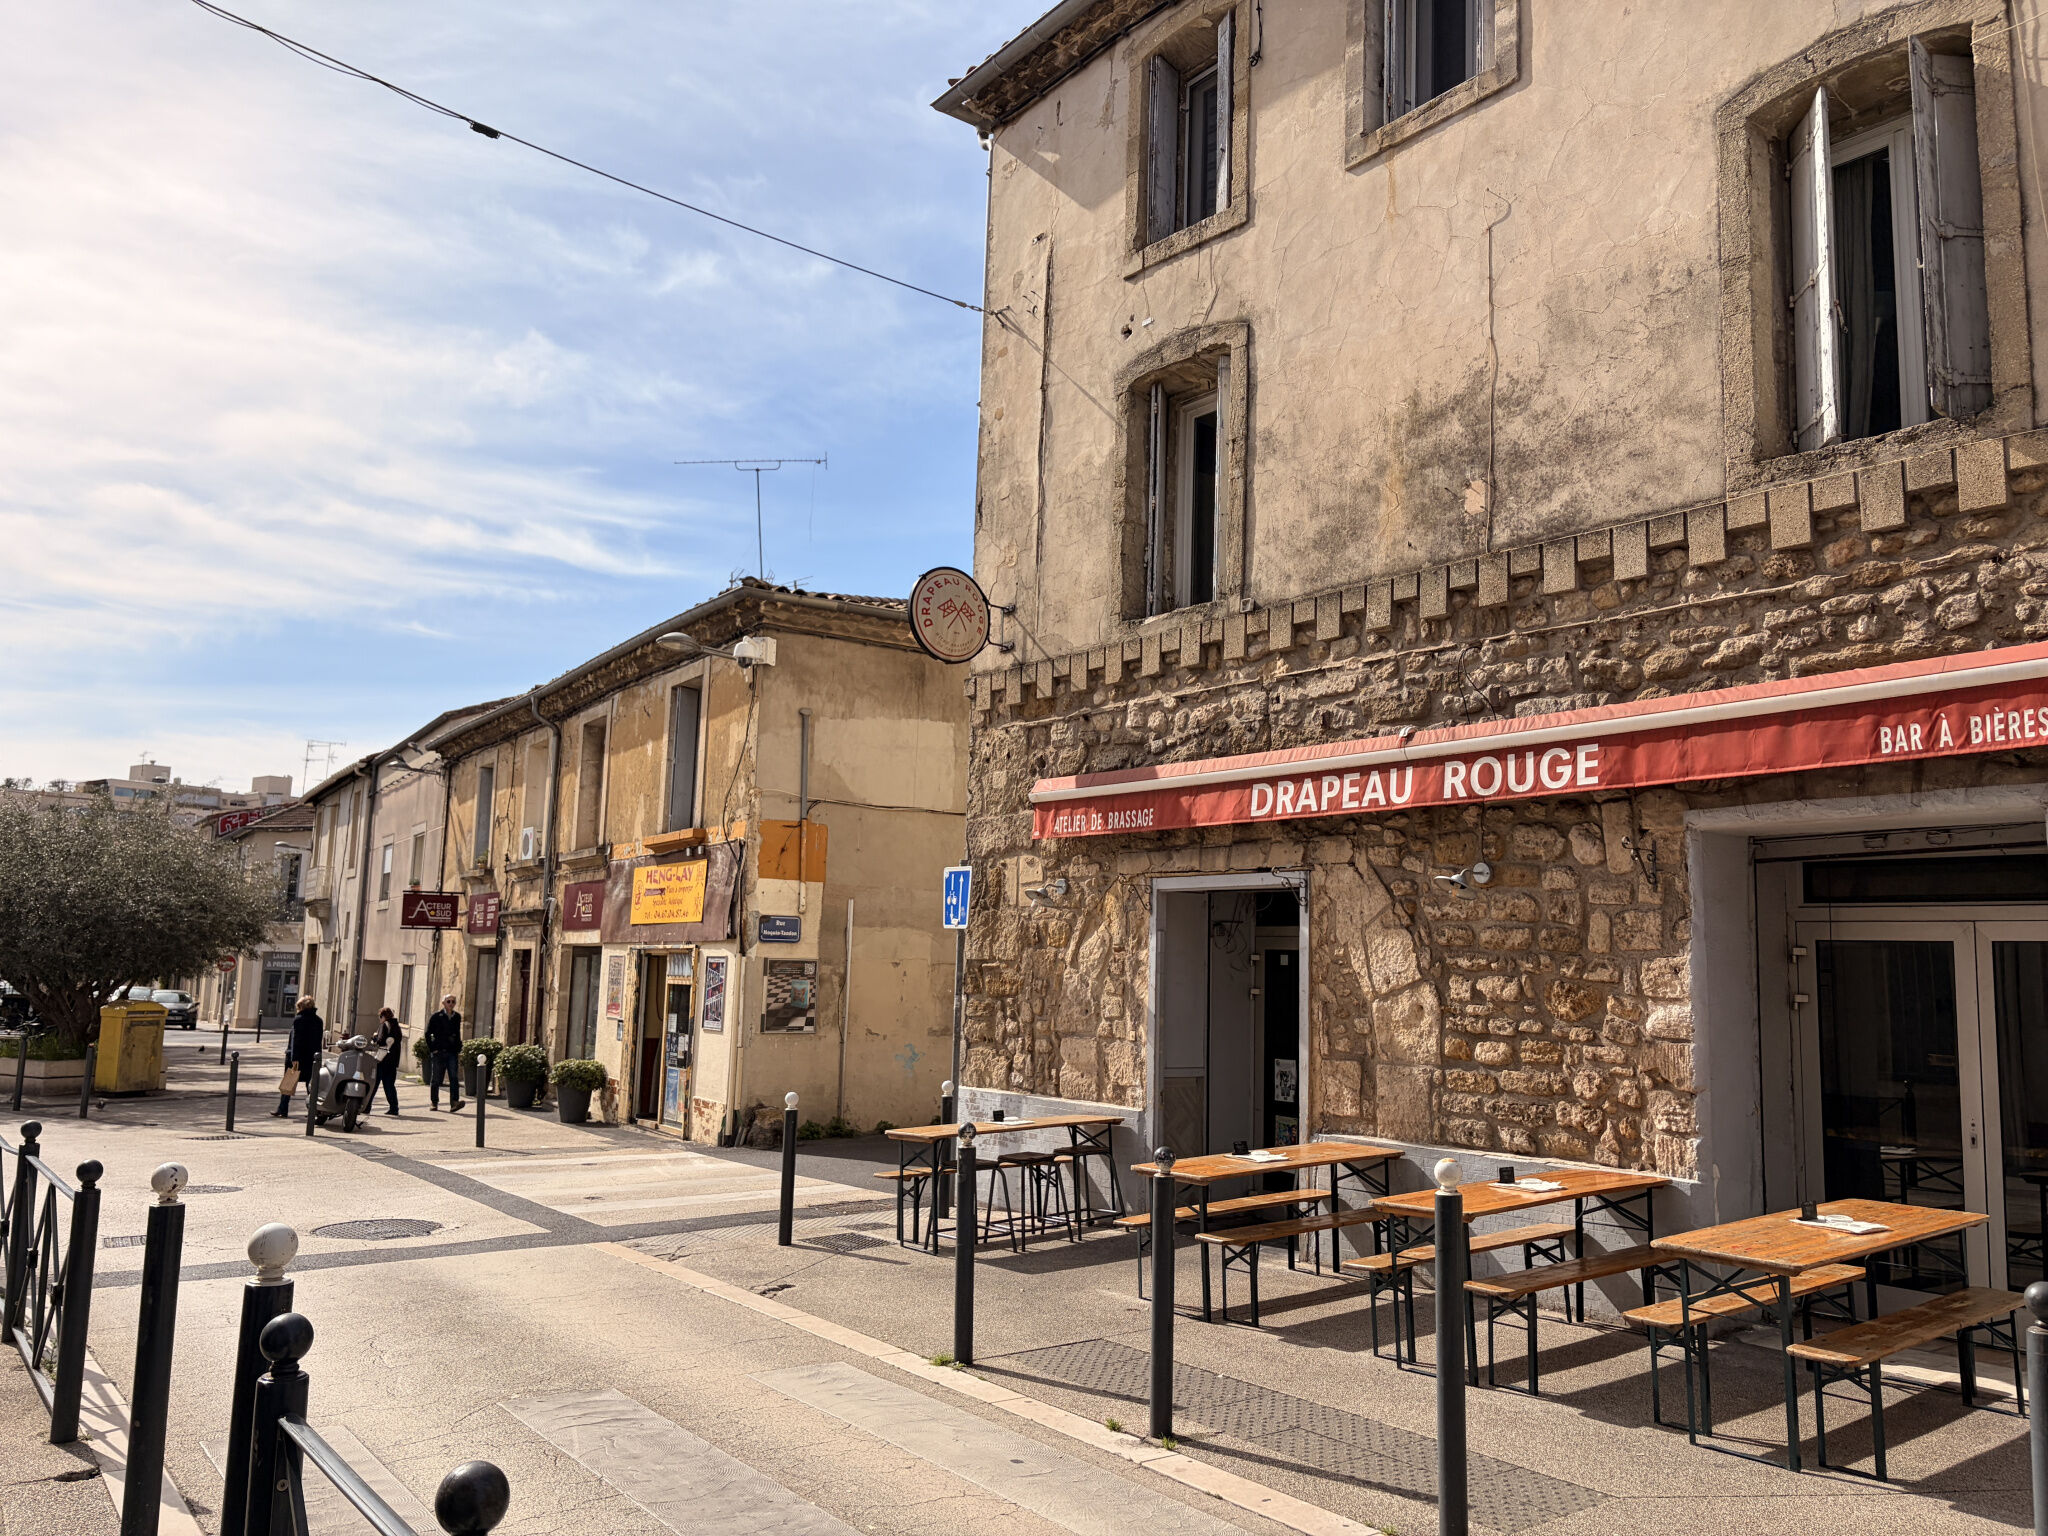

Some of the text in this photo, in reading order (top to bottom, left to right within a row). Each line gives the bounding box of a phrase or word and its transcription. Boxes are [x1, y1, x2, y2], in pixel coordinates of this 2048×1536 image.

[921, 577, 984, 637] DRAPEAU ROUGE
[1880, 706, 2048, 754] BAR À BIÈRES
[1250, 743, 1599, 817] DRAPEAU ROUGE
[1053, 808, 1154, 833] ATELIER DE BRASSAGE
[408, 900, 452, 918] ACTEUR
